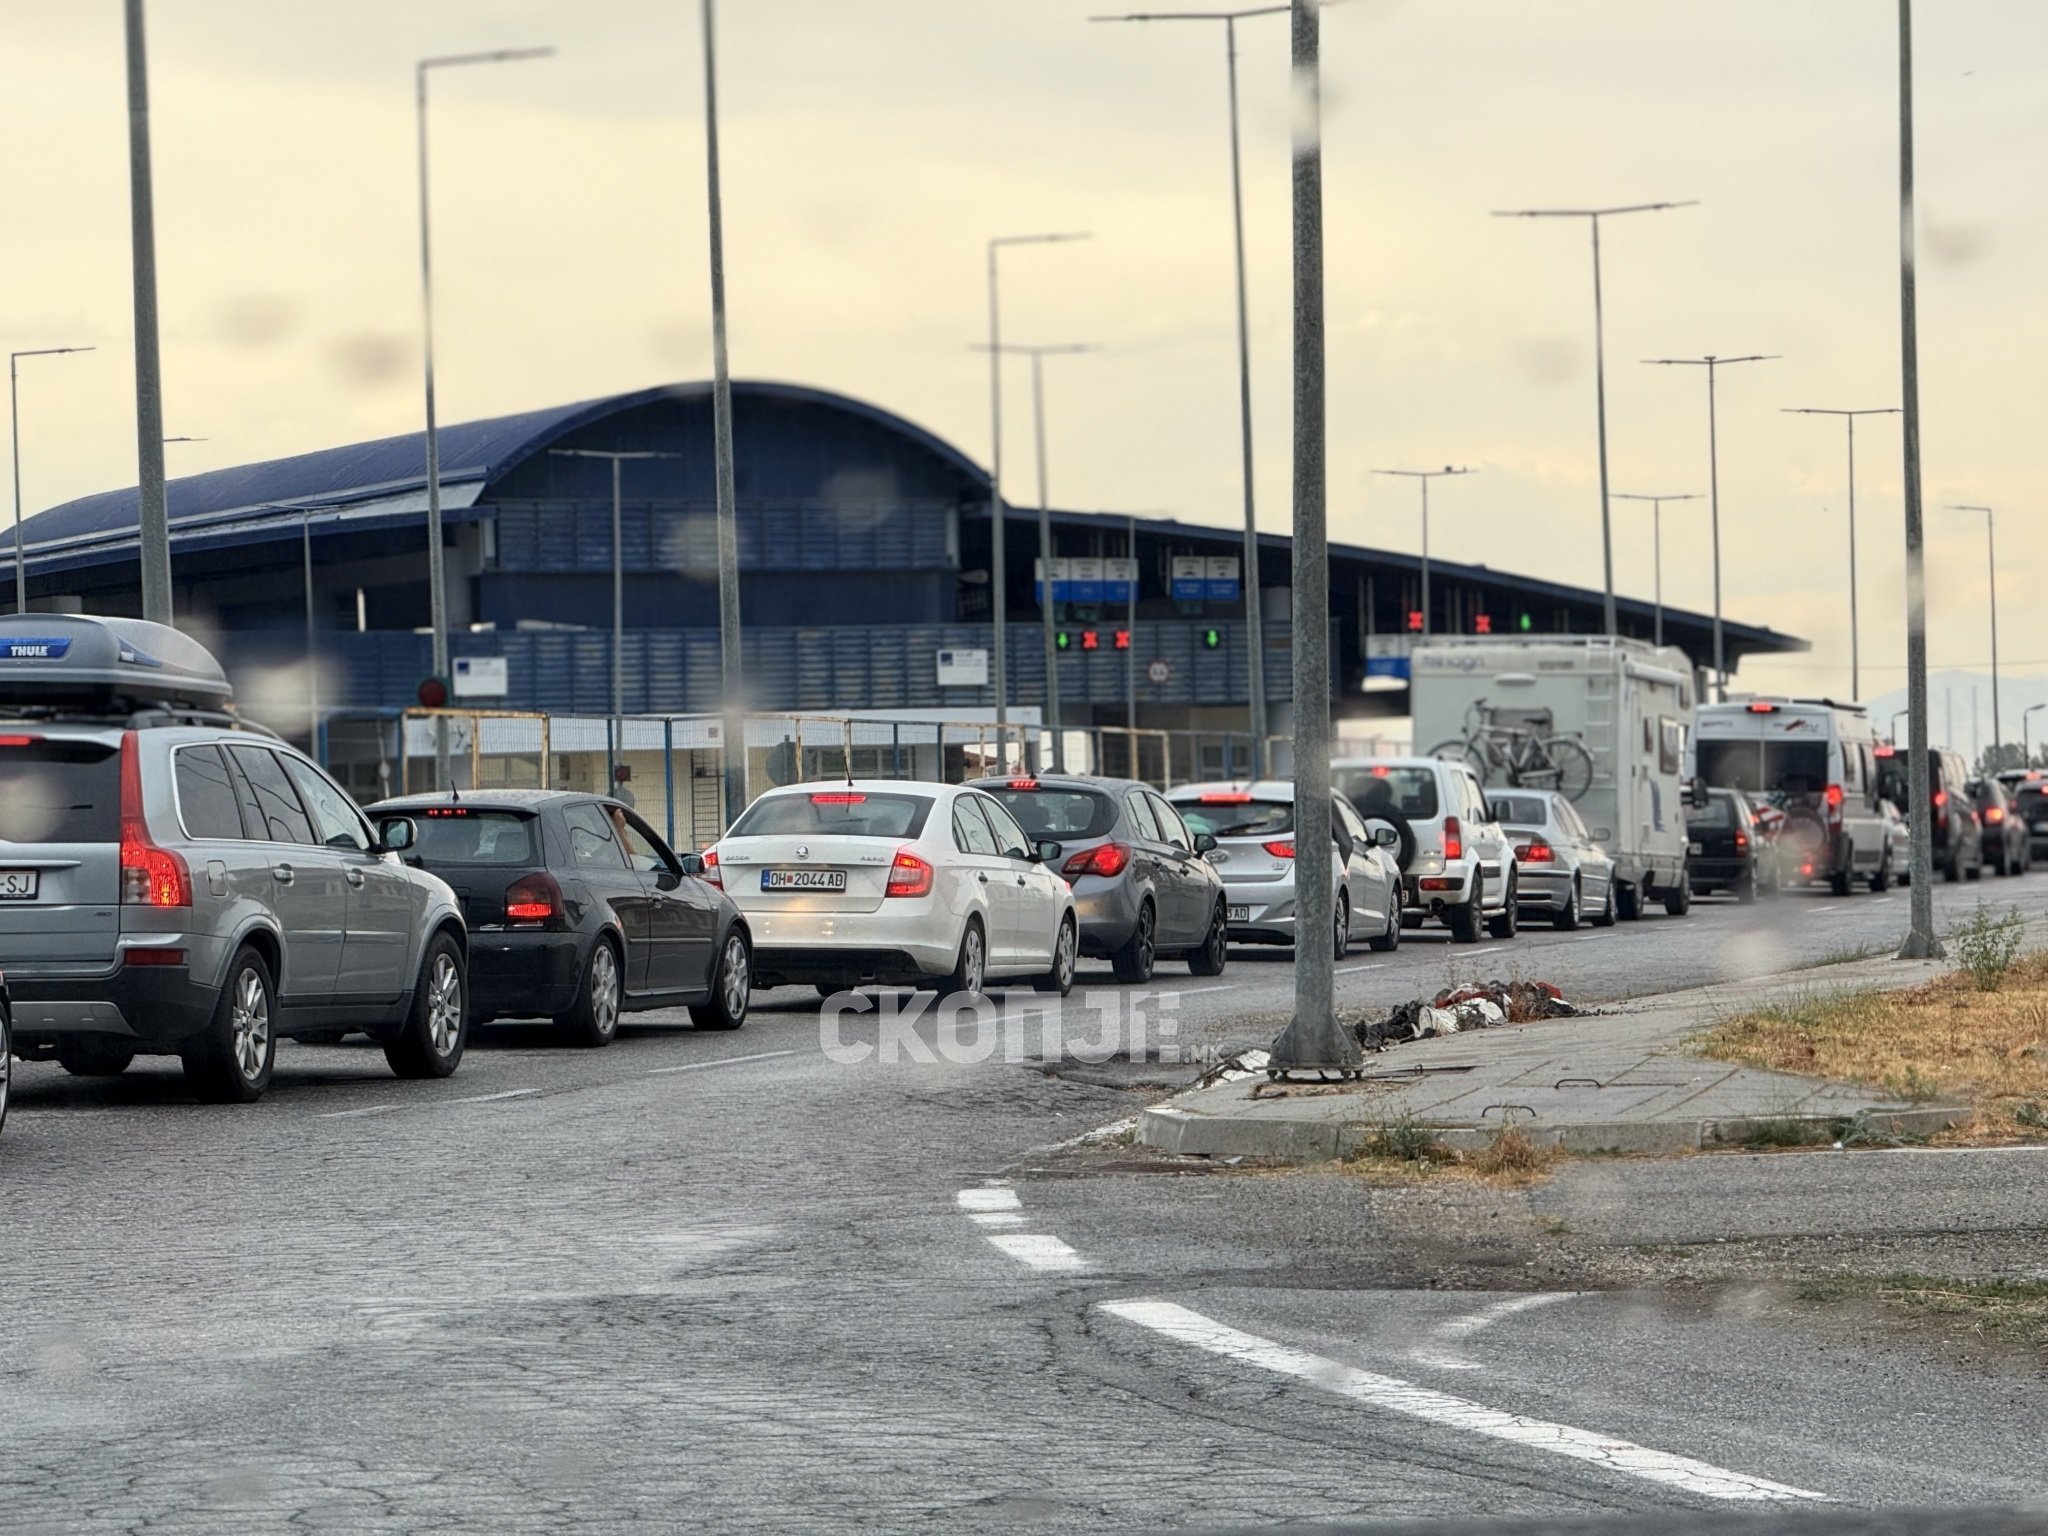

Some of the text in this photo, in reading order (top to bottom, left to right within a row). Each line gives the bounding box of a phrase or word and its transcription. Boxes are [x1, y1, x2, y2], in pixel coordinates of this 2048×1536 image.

[11, 646, 47, 656] THULE
[771, 872, 786, 886] OH
[794, 872, 825, 886] 2044
[1235, 908, 1246, 918] AD
